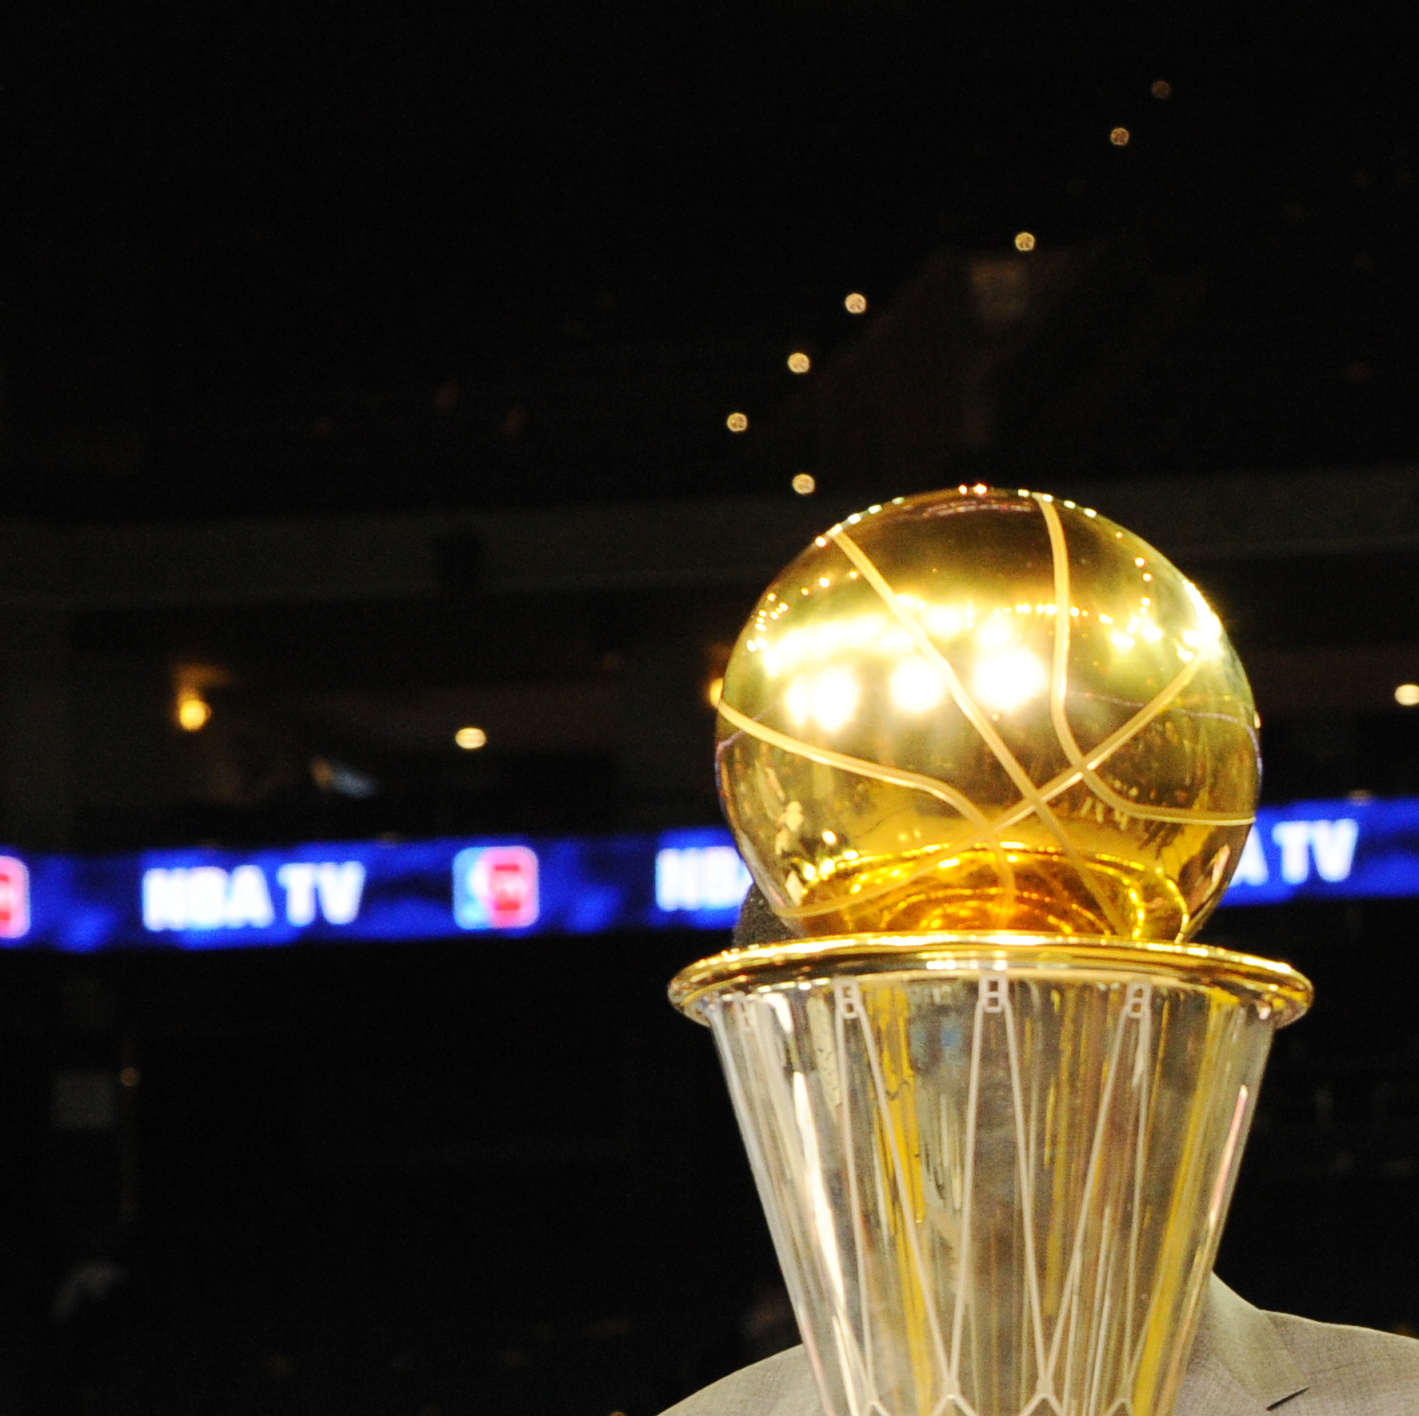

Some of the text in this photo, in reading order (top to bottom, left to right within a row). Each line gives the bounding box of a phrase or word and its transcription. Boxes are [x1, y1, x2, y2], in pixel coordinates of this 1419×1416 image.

[1271, 818, 1360, 885] TV
[142, 860, 367, 932] NBA TV
